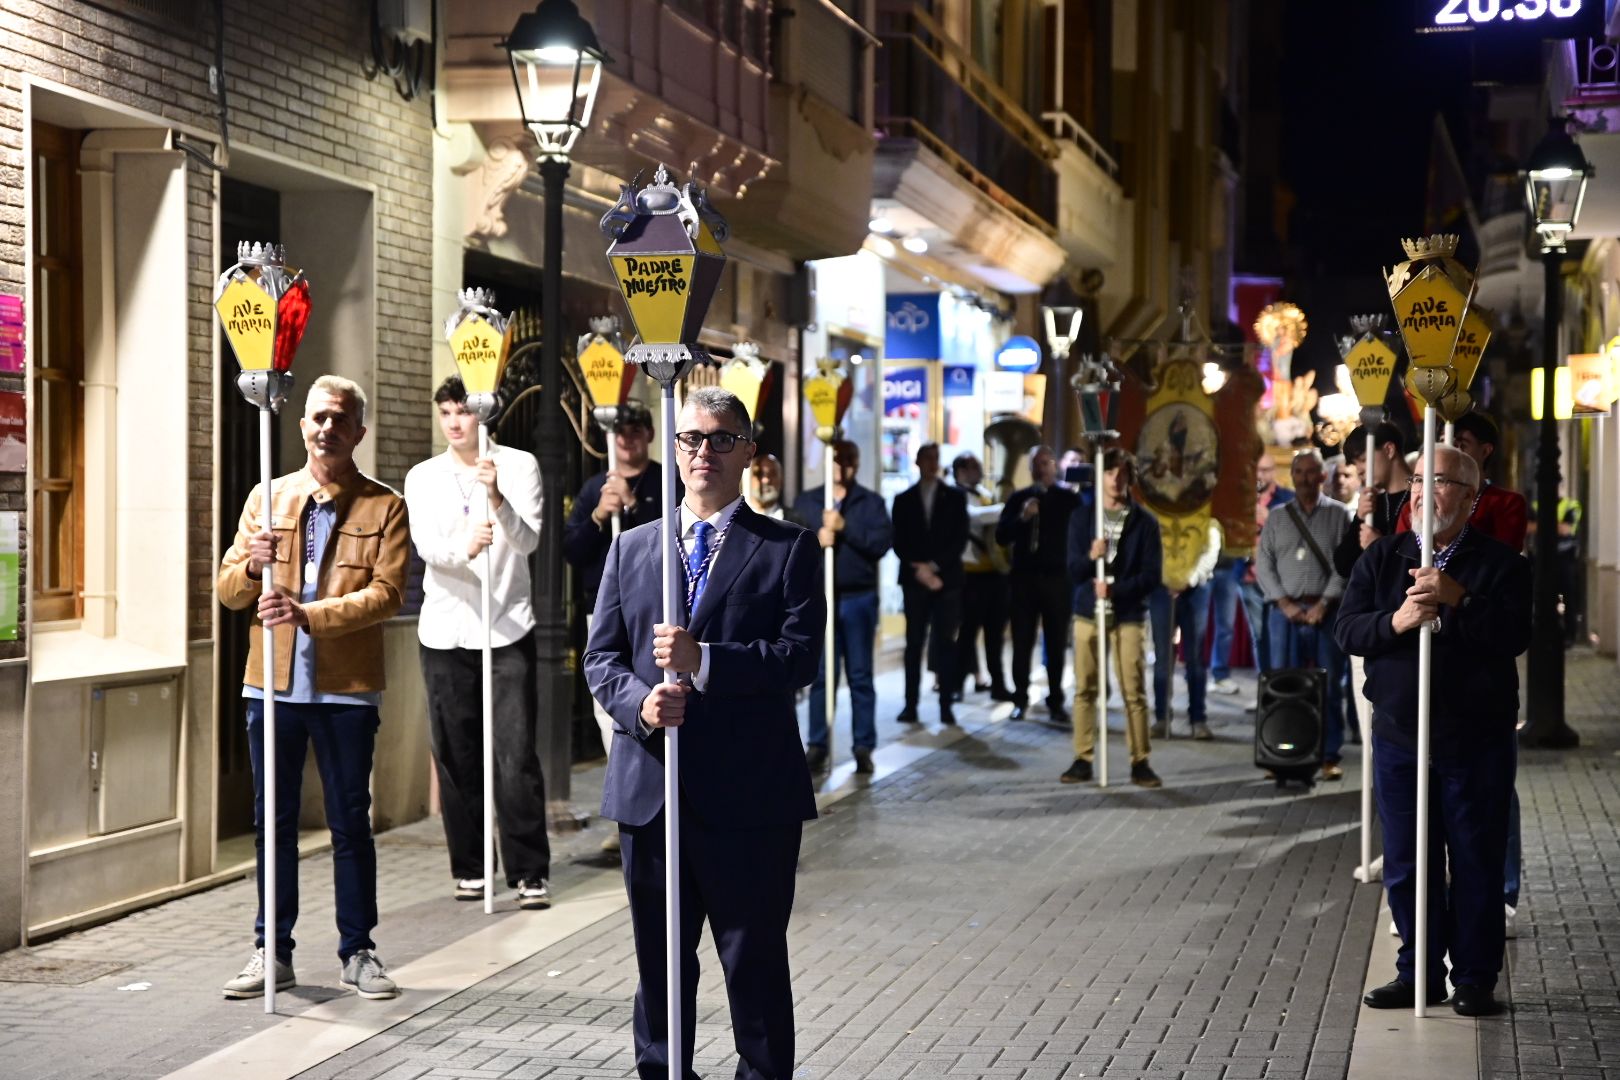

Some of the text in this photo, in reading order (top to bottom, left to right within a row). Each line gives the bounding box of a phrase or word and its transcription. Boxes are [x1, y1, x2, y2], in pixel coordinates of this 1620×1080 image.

[624, 258, 684, 278] PADRE
[623, 274, 687, 298] NUESTRO
[233, 299, 264, 318] AVE
[1411, 296, 1448, 316] AVE
[228, 318, 272, 335] MARIA
[1403, 315, 1456, 333] MARIA
[462, 335, 490, 350] AVE
[457, 350, 497, 365] MARIA
[1358, 353, 1385, 367] AVE
[1352, 367, 1390, 380] MARIA
[881, 380, 921, 399] DIGI
